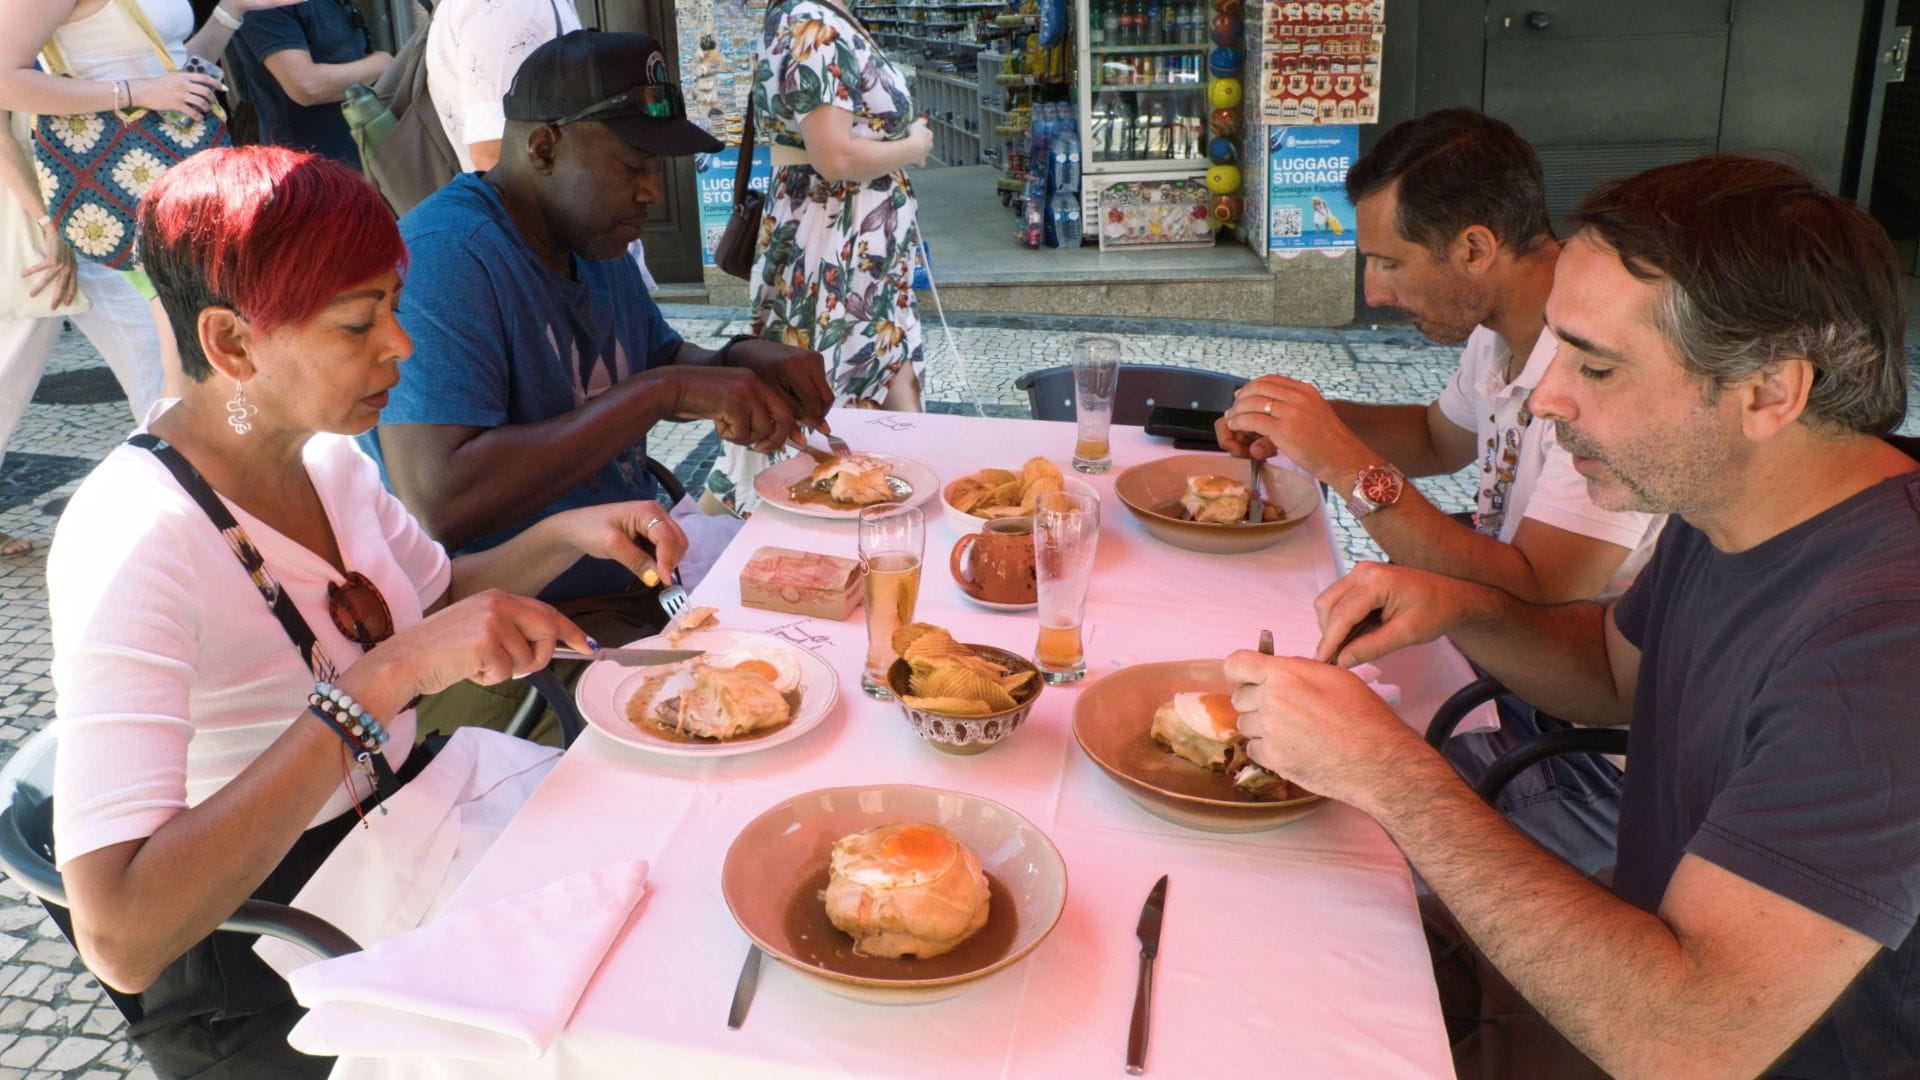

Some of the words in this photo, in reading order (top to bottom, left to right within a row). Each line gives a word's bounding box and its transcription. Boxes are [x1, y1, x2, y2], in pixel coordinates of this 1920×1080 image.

[1273, 157, 1349, 170] LUGGAGE
[702, 177, 770, 191] LUGGE
[1273, 170, 1347, 184] STORAGE
